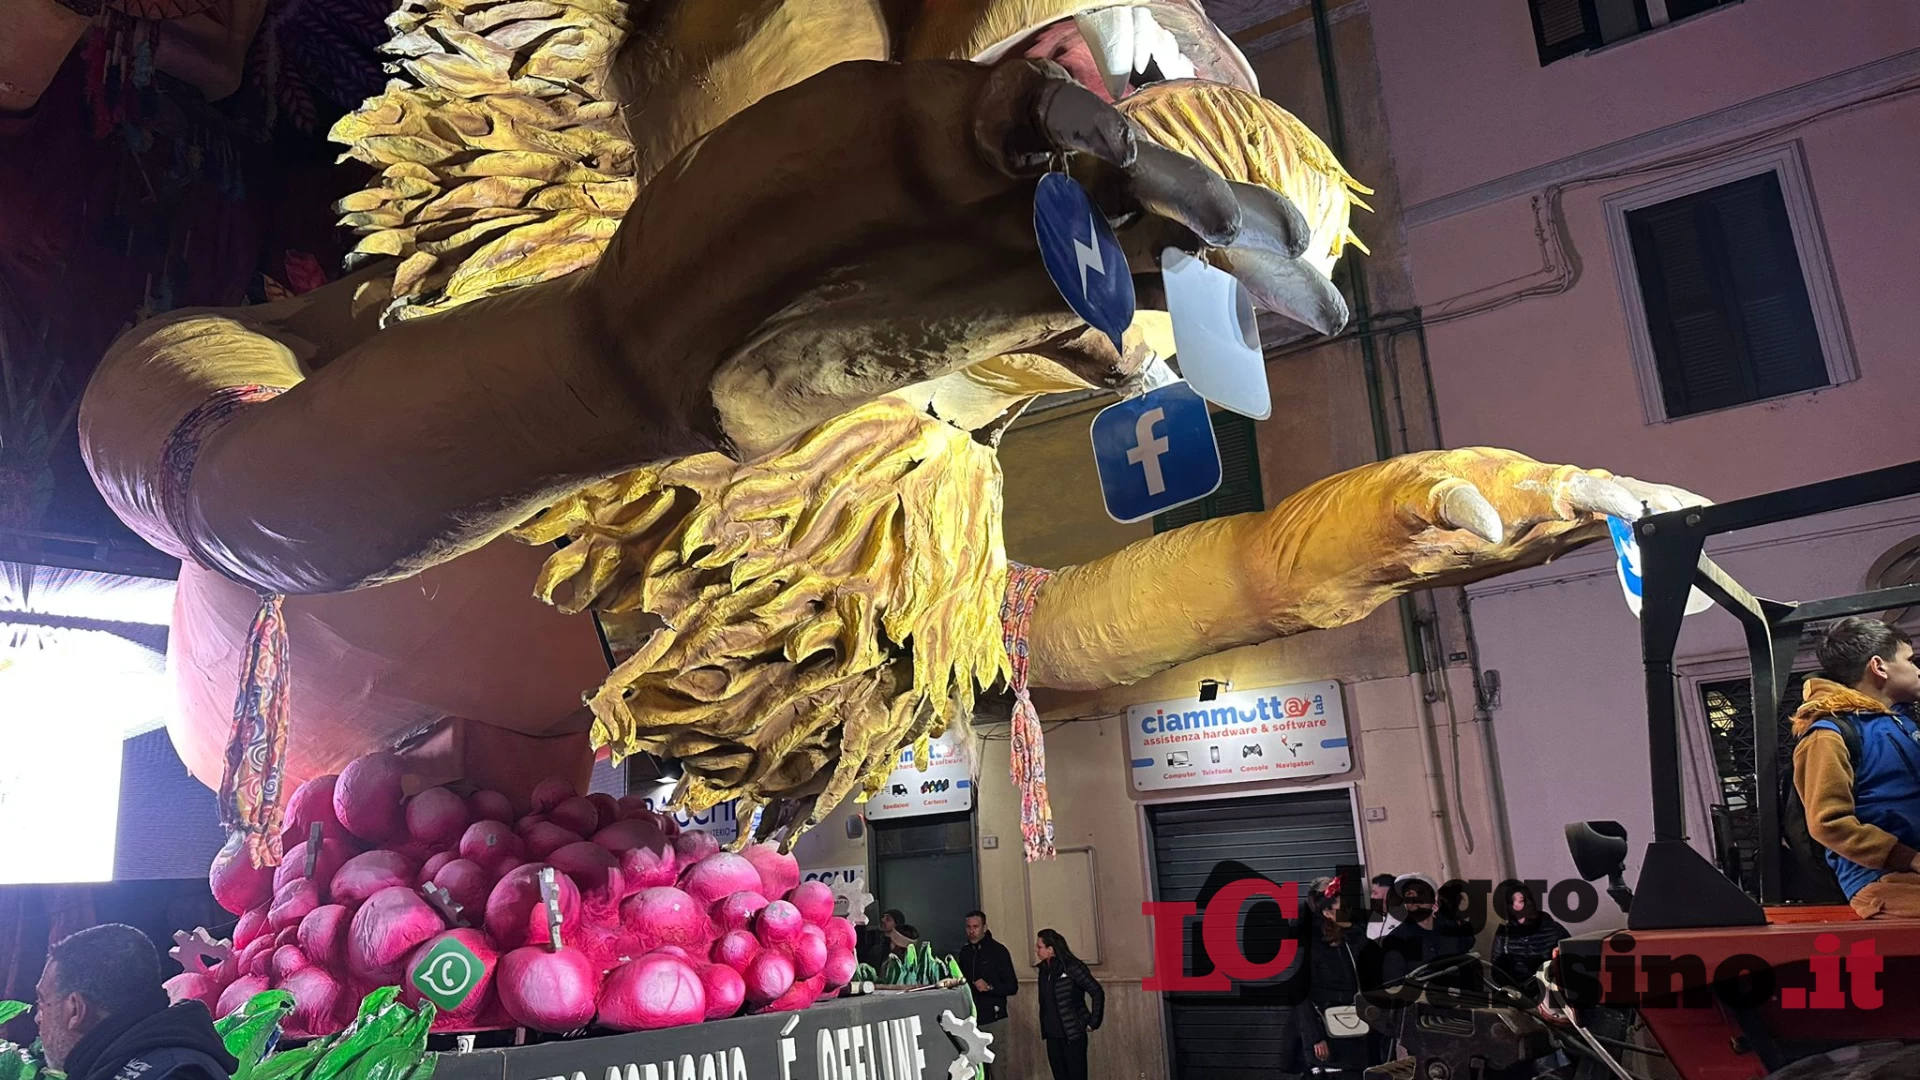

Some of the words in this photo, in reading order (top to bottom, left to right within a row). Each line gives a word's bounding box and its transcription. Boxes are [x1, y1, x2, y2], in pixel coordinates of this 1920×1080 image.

[1314, 694, 1324, 716] lab
[1143, 733, 1201, 746] assistenza
[1203, 725, 1258, 740] hardware
[1261, 723, 1270, 733] &
[1273, 718, 1327, 732] software
[1163, 771, 1197, 780] Computer
[1202, 767, 1233, 776] Telefonia
[1240, 763, 1269, 772] Console
[1275, 759, 1315, 770] Navigatori
